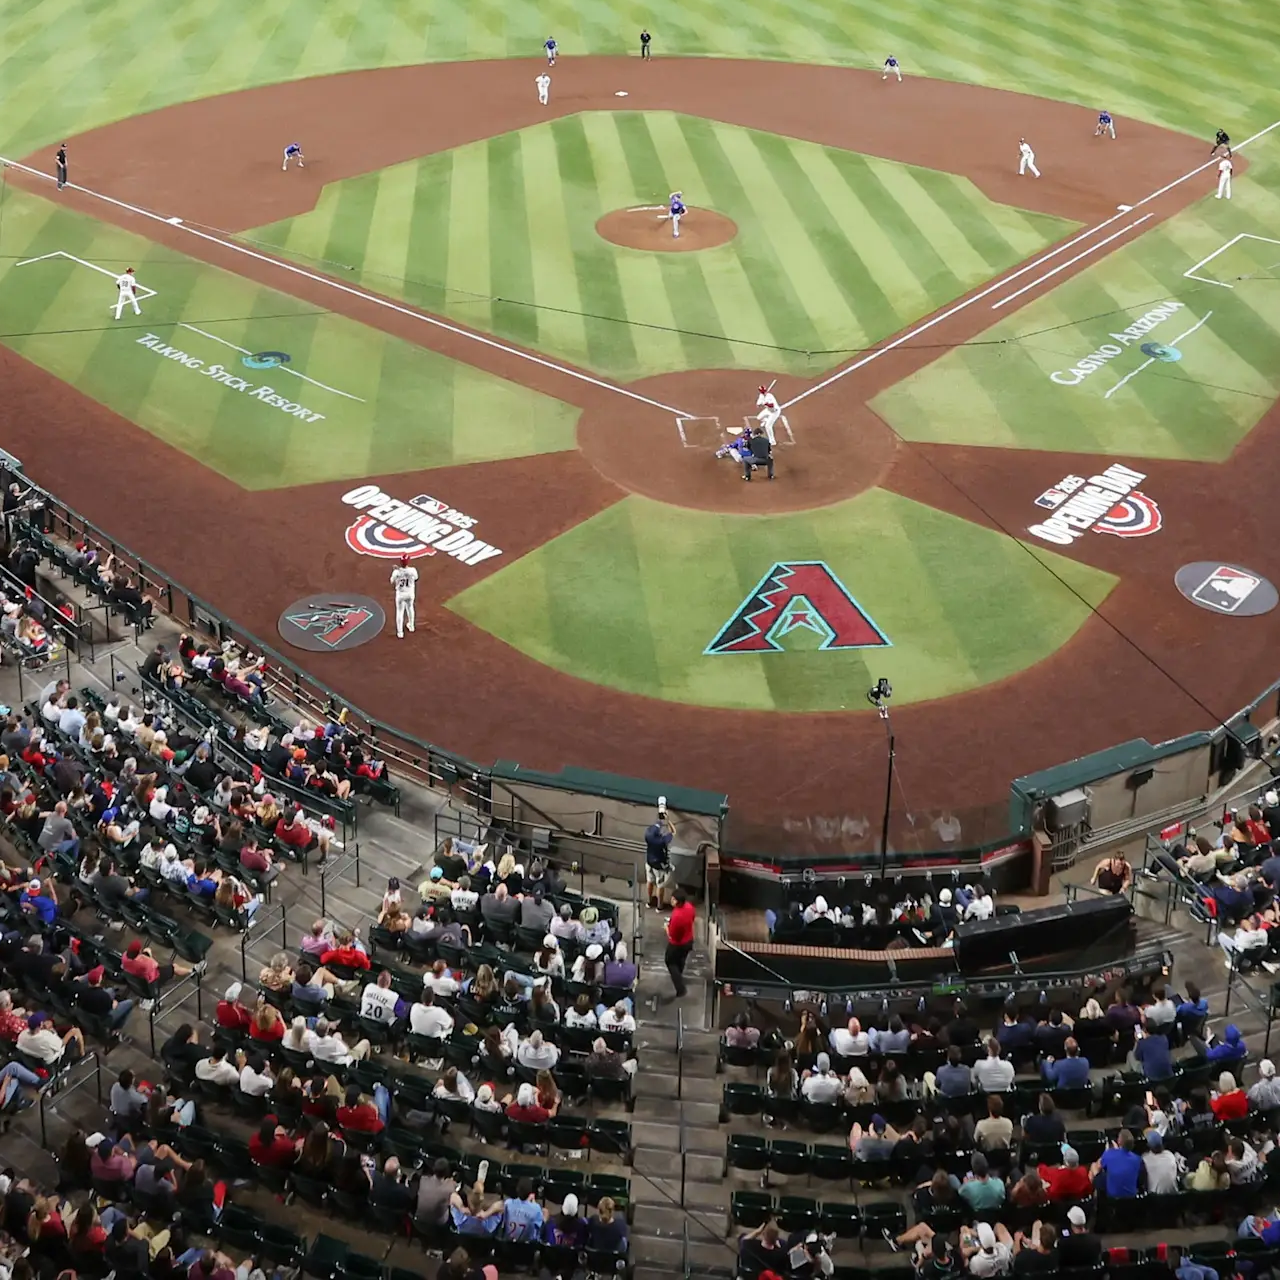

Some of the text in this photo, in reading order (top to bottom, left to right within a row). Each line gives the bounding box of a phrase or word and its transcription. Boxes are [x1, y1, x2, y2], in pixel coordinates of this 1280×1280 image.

[136, 332, 326, 423] TALKING STICK RESORT
[1050, 301, 1185, 385] CASINO ARIZONA
[341, 485, 503, 566] OPENING DAY
[438, 509, 479, 529] 2025
[1027, 463, 1147, 545] OPENING DAY
[399, 578, 409, 588] 31
